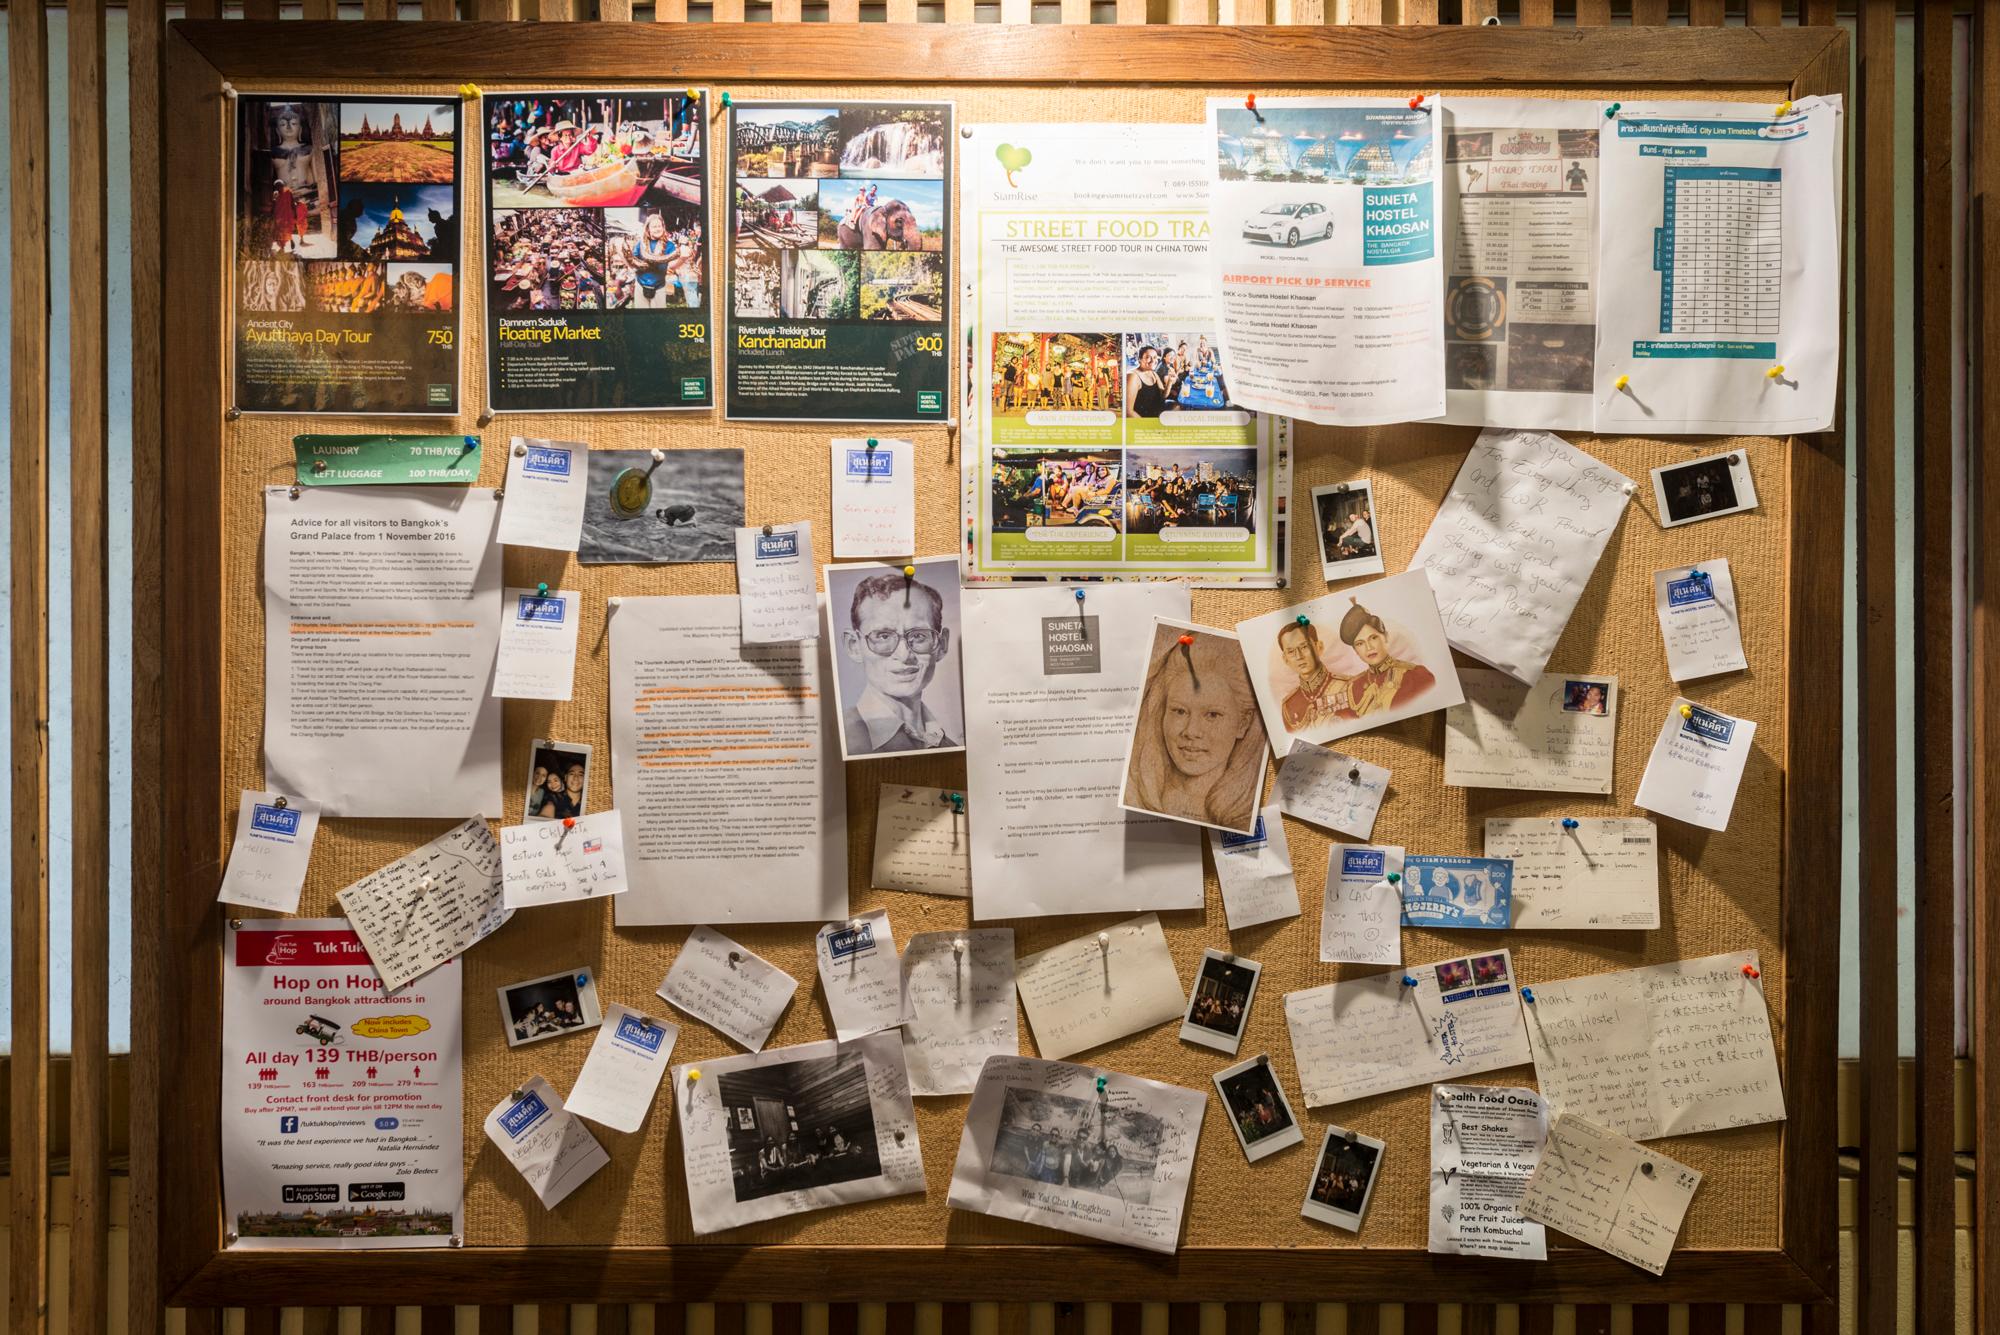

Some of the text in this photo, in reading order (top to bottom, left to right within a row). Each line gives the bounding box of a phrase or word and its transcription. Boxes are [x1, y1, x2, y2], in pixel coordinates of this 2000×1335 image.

[1700, 128, 1711, 136] City
[1728, 128, 1756, 136] Timetable
[994, 192, 1038, 201] SiamRise
[1367, 193, 1417, 206] SUNETA
[1367, 209, 1418, 221] HOSTEL
[1007, 221, 1210, 237] STREET FOOD TRA
[1367, 220, 1429, 236] KHAOSAN
[1223, 275, 1272, 285] AIRPORT
[1276, 277, 1302, 286] PICK
[1325, 279, 1371, 288] SERVICE
[247, 320, 293, 330] Ancient City
[538, 318, 567, 326] Saduak
[500, 327, 600, 343] Floating Market
[679, 324, 704, 338] 350
[739, 327, 826, 335] River Kwai Tour
[247, 329, 372, 345] Ayutthaya Day Tour
[427, 331, 453, 344] 750
[739, 335, 826, 349] Kanchanaburi
[917, 337, 942, 351] 900
[313, 446, 359, 454] LAUNDRY
[315, 470, 383, 478] LEFT LUGGAGE
[291, 519, 322, 527] Advice
[401, 520, 448, 529] Bangkok's
[291, 532, 319, 540] Grand
[322, 533, 351, 541] Palace
[386, 533, 431, 541] November
[434, 533, 455, 541] 2016
[1049, 622, 1084, 631] SUNETA
[1049, 633, 1084, 641] HOSTEL
[1049, 644, 1093, 653] KHAOSAN
[280, 947, 297, 955] Hop
[313, 942, 364, 953] Tuk Tuk
[274, 975, 383, 992] Hop on Hop
[1537, 984, 1575, 1005] hank
[264, 995, 425, 1007] around Bangkok attractions in
[246, 1049, 438, 1066] All day 139 THB/person
[266, 1093, 422, 1104] Contact front desk for promotion
[1441, 1093, 1538, 1108] ealth Food Oasis
[1461, 1123, 1508, 1132] Best Shakes
[297, 1138, 351, 1146] best experience
[305, 1162, 331, 1170] service,
[334, 1161, 352, 1169] really
[373, 1160, 388, 1168] idea
[1461, 1160, 1501, 1170] Vegetarian
[396, 1168, 412, 1176] Zolo
[296, 1191, 336, 1202] App Store
[361, 1190, 403, 1200] Google play
[1483, 1204, 1512, 1213] Organic
[1460, 1214, 1525, 1224] Pure Fruit Juices
